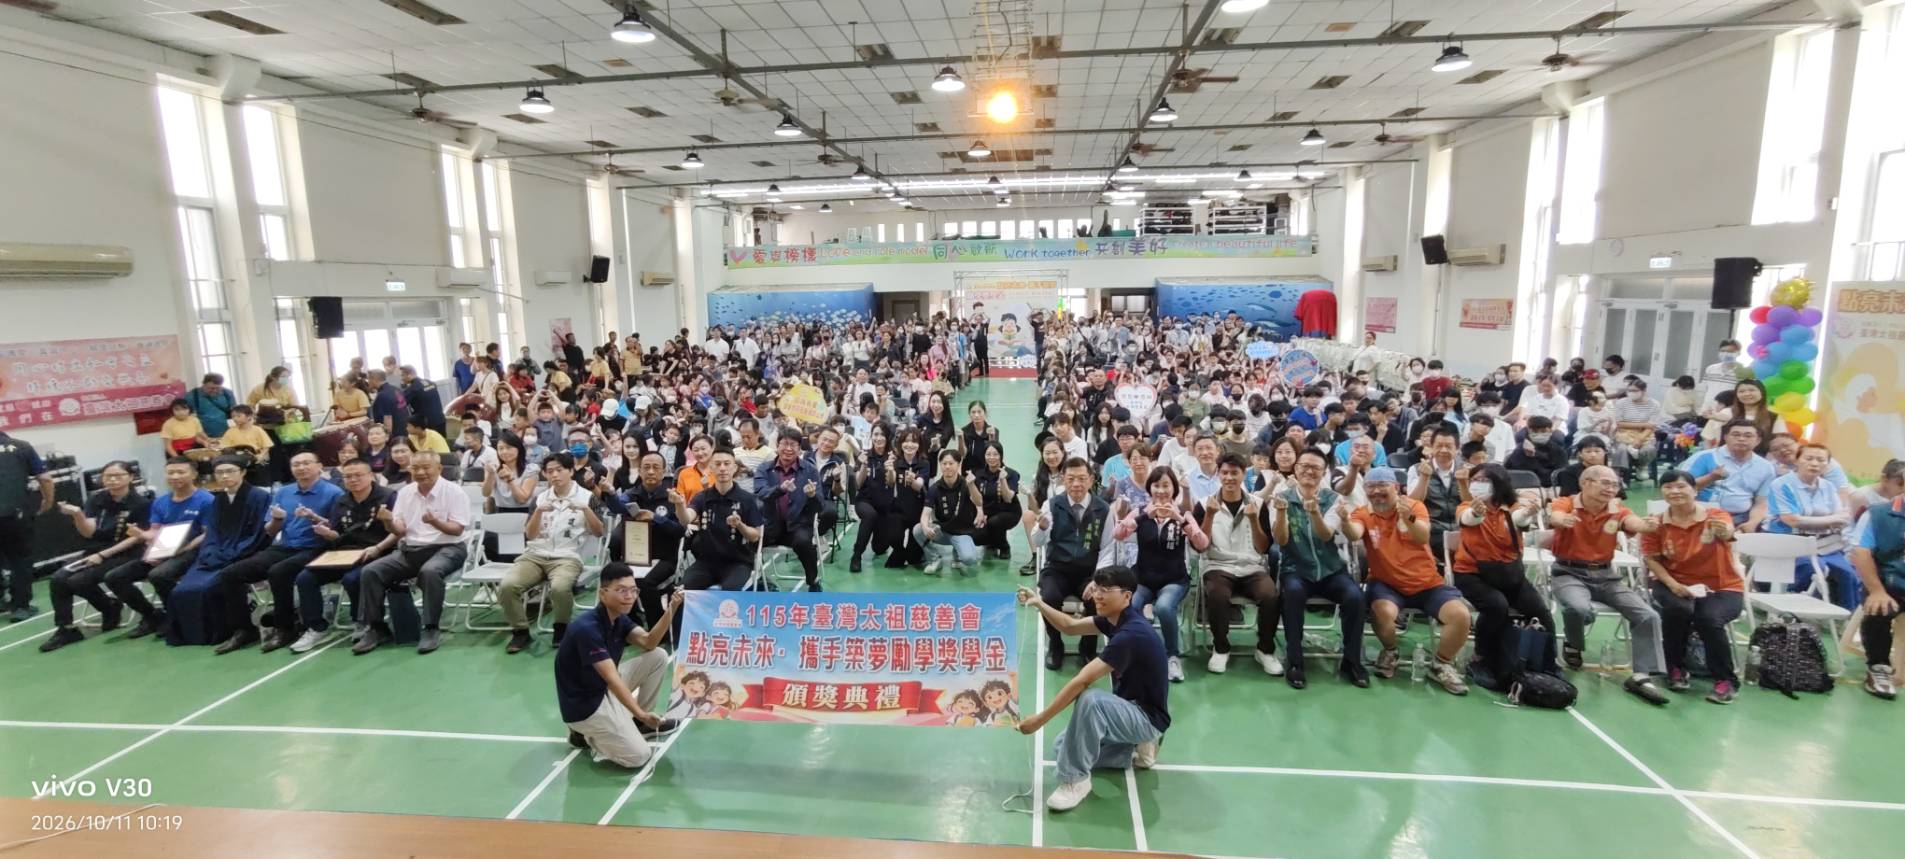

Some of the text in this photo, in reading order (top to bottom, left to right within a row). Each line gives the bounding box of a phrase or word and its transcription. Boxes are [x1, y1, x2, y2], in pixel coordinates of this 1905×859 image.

[746, 602, 982, 632] 115年臺灣太祖慈善會
[782, 683, 901, 711] 頒獎典禮
